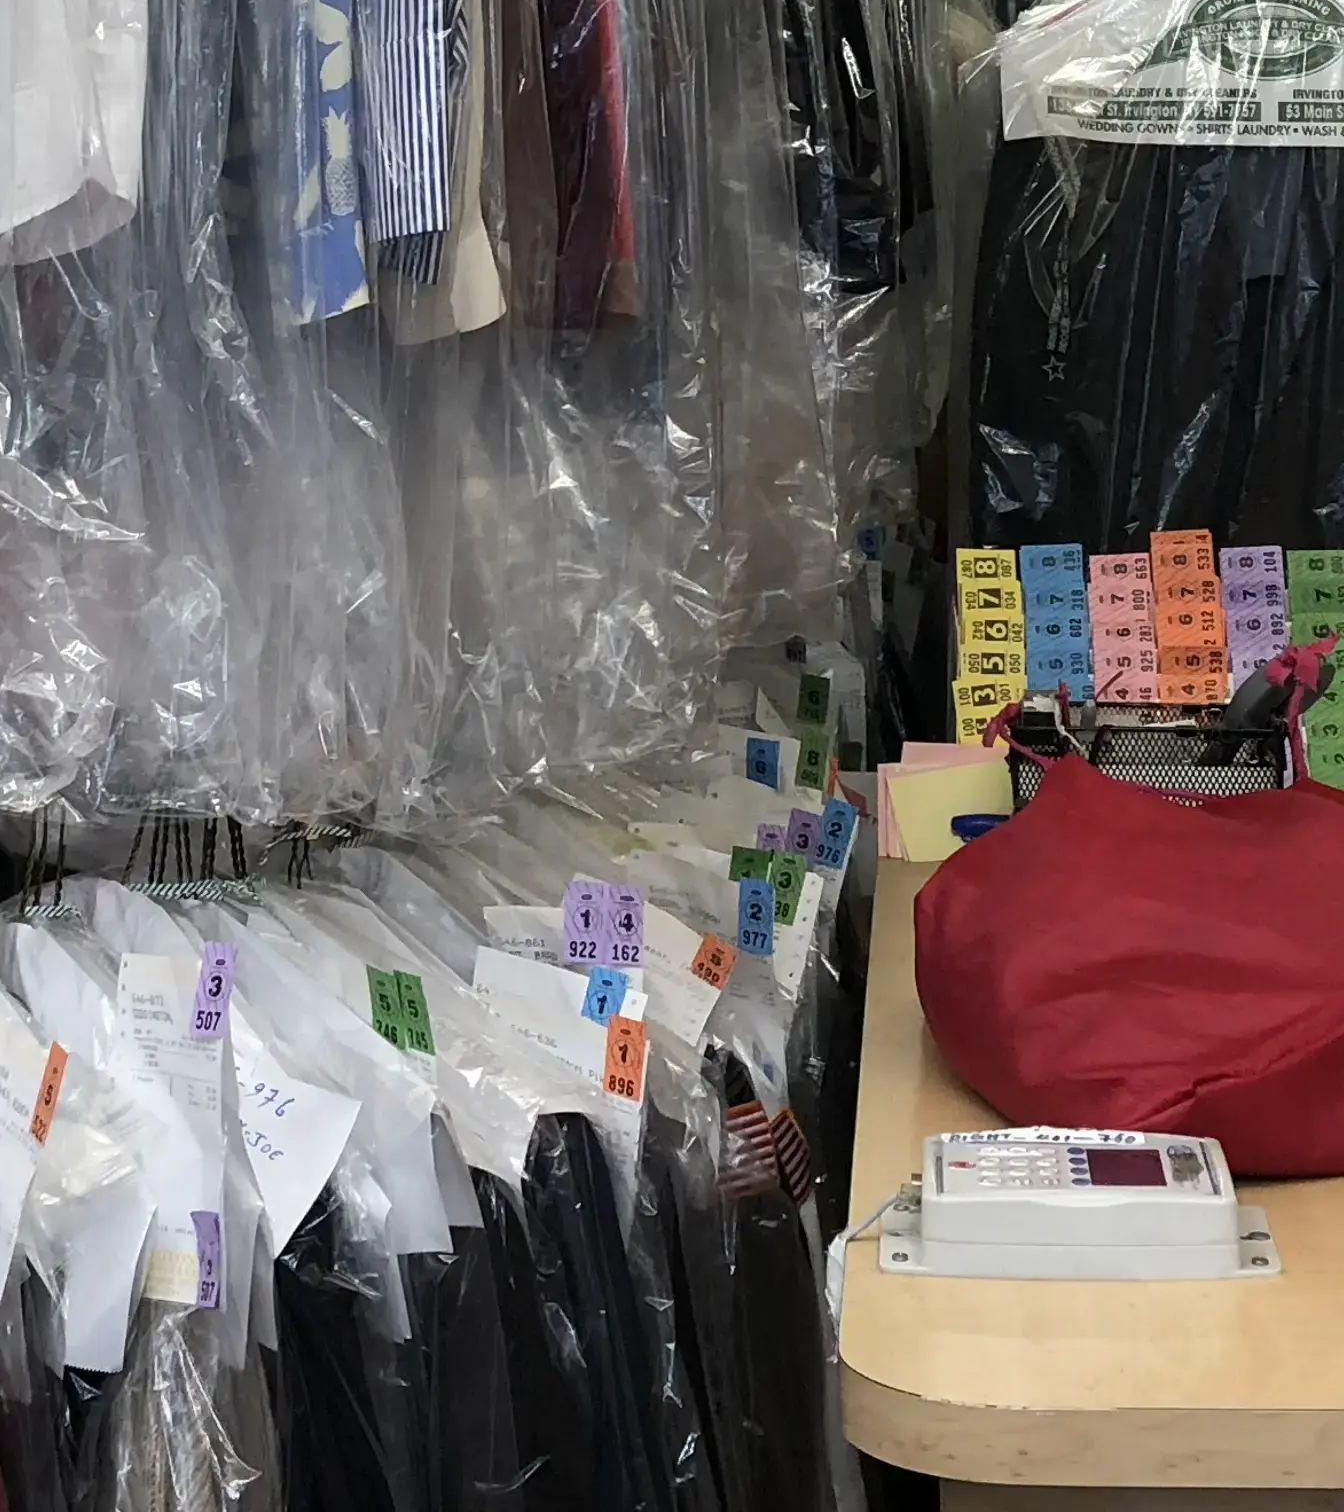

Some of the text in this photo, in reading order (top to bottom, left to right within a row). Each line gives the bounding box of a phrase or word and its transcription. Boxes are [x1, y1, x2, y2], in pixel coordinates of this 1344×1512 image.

[1291, 19, 1312, 31] DRY
[1285, 106, 1301, 119] 53
[1304, 105, 1333, 120] Main
[1077, 119, 1134, 134] WEDDING
[1196, 124, 1233, 136] SHIRTS
[1237, 124, 1290, 136] LAUNDRY
[1301, 124, 1337, 136] WASH
[1135, 557, 1148, 580] 663
[1197, 548, 1210, 570] 533
[1263, 551, 1277, 573] 104
[1005, 591, 1017, 610] 034
[1071, 589, 1084, 611] 318
[1132, 589, 1146, 611] 800
[1202, 580, 1215, 603] 528
[972, 620, 1024, 643] 042 042
[1069, 618, 1082, 638] 602
[1201, 610, 1215, 632] 512
[1270, 613, 1284, 636] 892
[968, 653, 1021, 674] 050 050
[1070, 652, 1083, 675] 930
[1140, 649, 1154, 672] 925
[1209, 650, 1223, 673] 538
[958, 683, 1012, 706] 001 001
[829, 822, 843, 838] 2
[816, 843, 839, 864] 976
[778, 871, 792, 890] 3
[580, 909, 592, 928] 1
[749, 903, 762, 921] 2
[569, 941, 597, 959] 922
[742, 930, 768, 949] 977
[611, 944, 640, 963] 162
[208, 975, 223, 998] 3
[379, 995, 391, 1012] 5
[407, 1000, 420, 1018] 5
[195, 1009, 222, 1032] 507
[618, 1043, 629, 1063] 1
[608, 1075, 634, 1097] 896
[200, 1280, 216, 1302] 507
